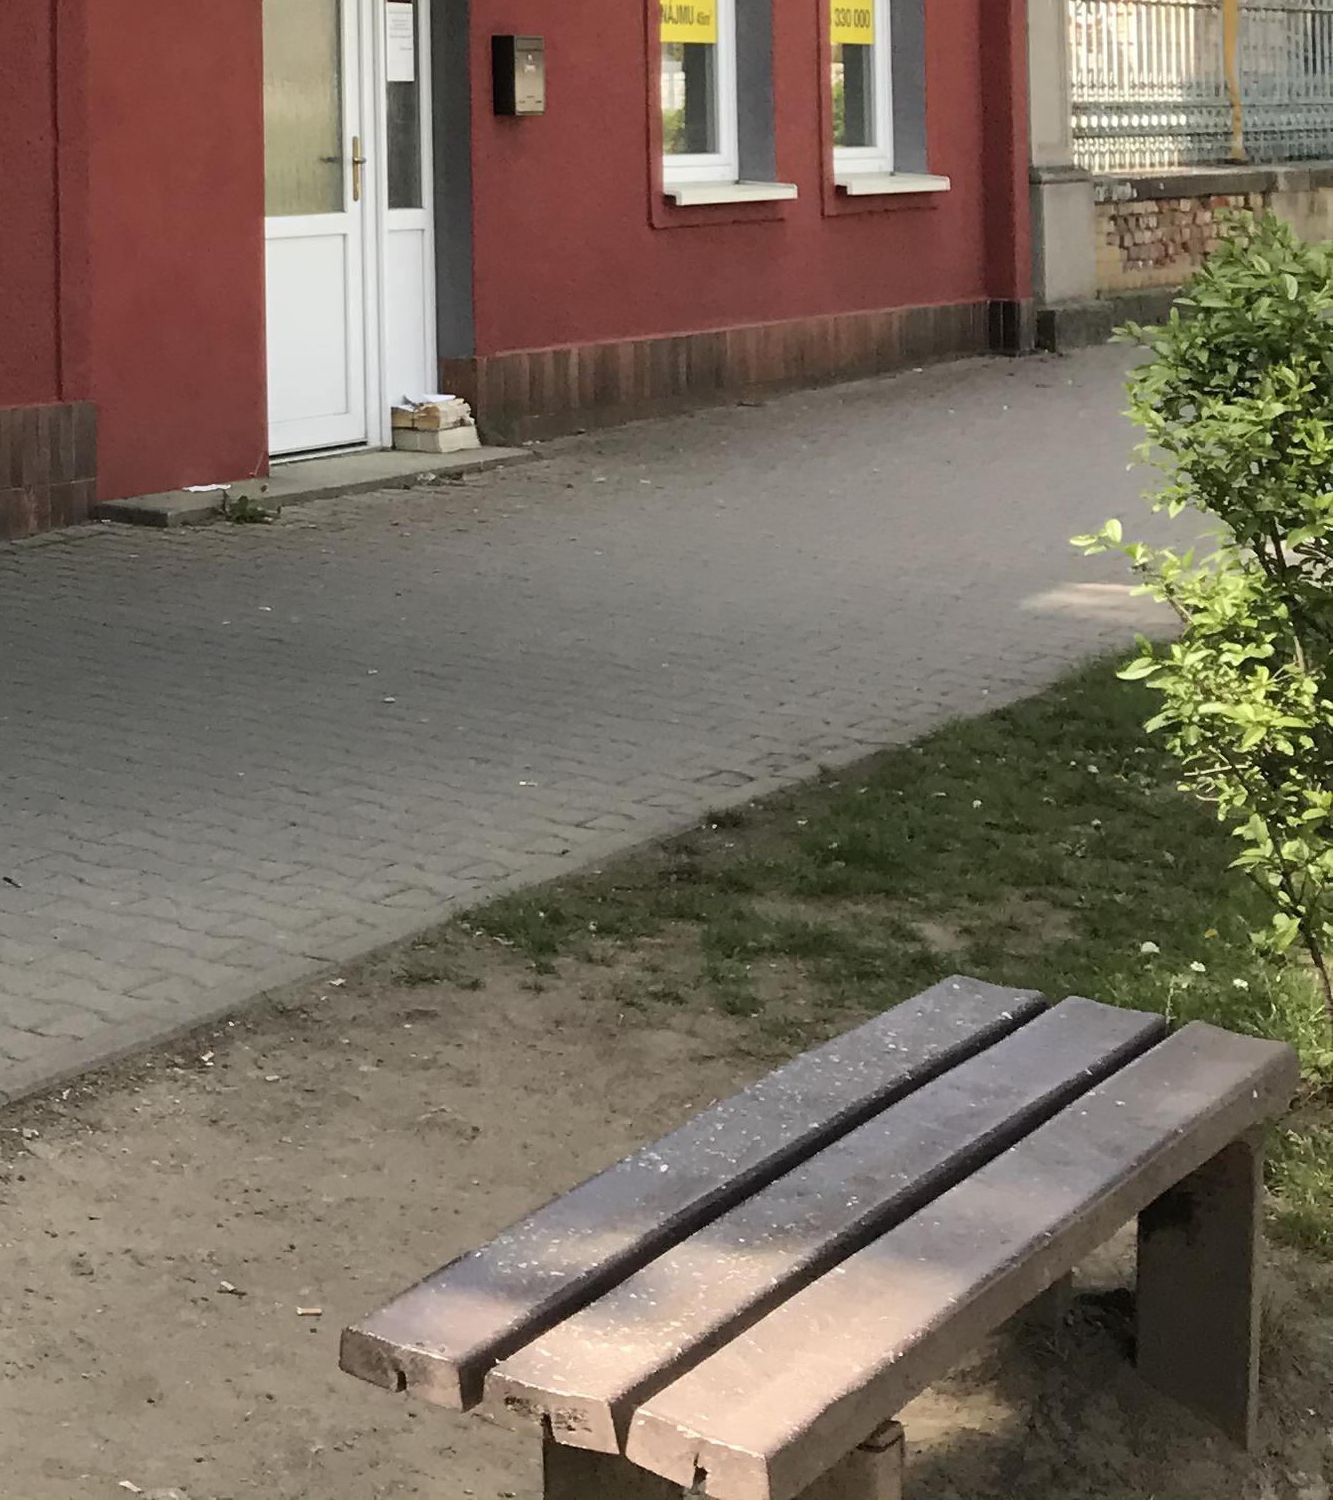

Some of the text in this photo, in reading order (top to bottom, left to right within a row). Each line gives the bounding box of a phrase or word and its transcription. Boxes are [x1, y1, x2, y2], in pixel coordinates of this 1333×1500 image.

[660, 2, 694, 25] NÁJMU
[834, 8, 870, 28] 330 000
